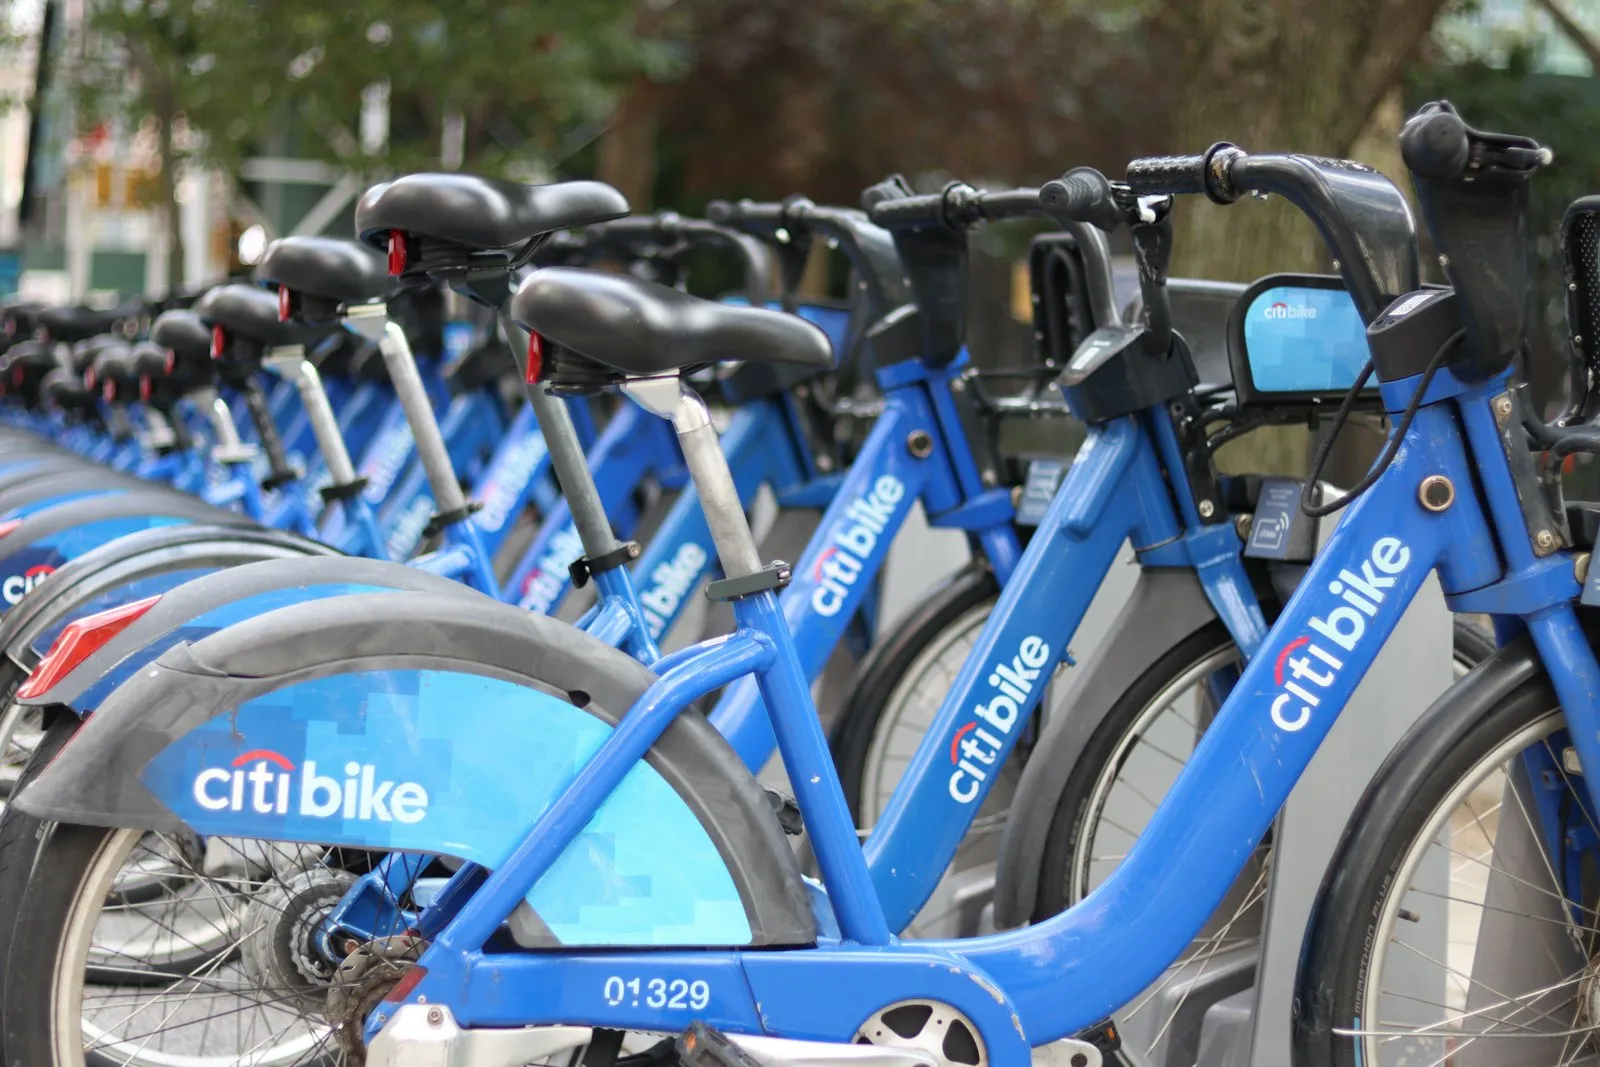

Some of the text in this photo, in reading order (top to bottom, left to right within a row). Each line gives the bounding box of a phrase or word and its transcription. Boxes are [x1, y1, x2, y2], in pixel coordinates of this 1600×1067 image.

[1264, 302, 1317, 319] citi bike
[811, 474, 905, 617] citi bike
[1270, 537, 1411, 731] citi bike
[949, 635, 1050, 803] citi bike
[193, 750, 428, 823] citi bike
[604, 976, 710, 1010] 01329
